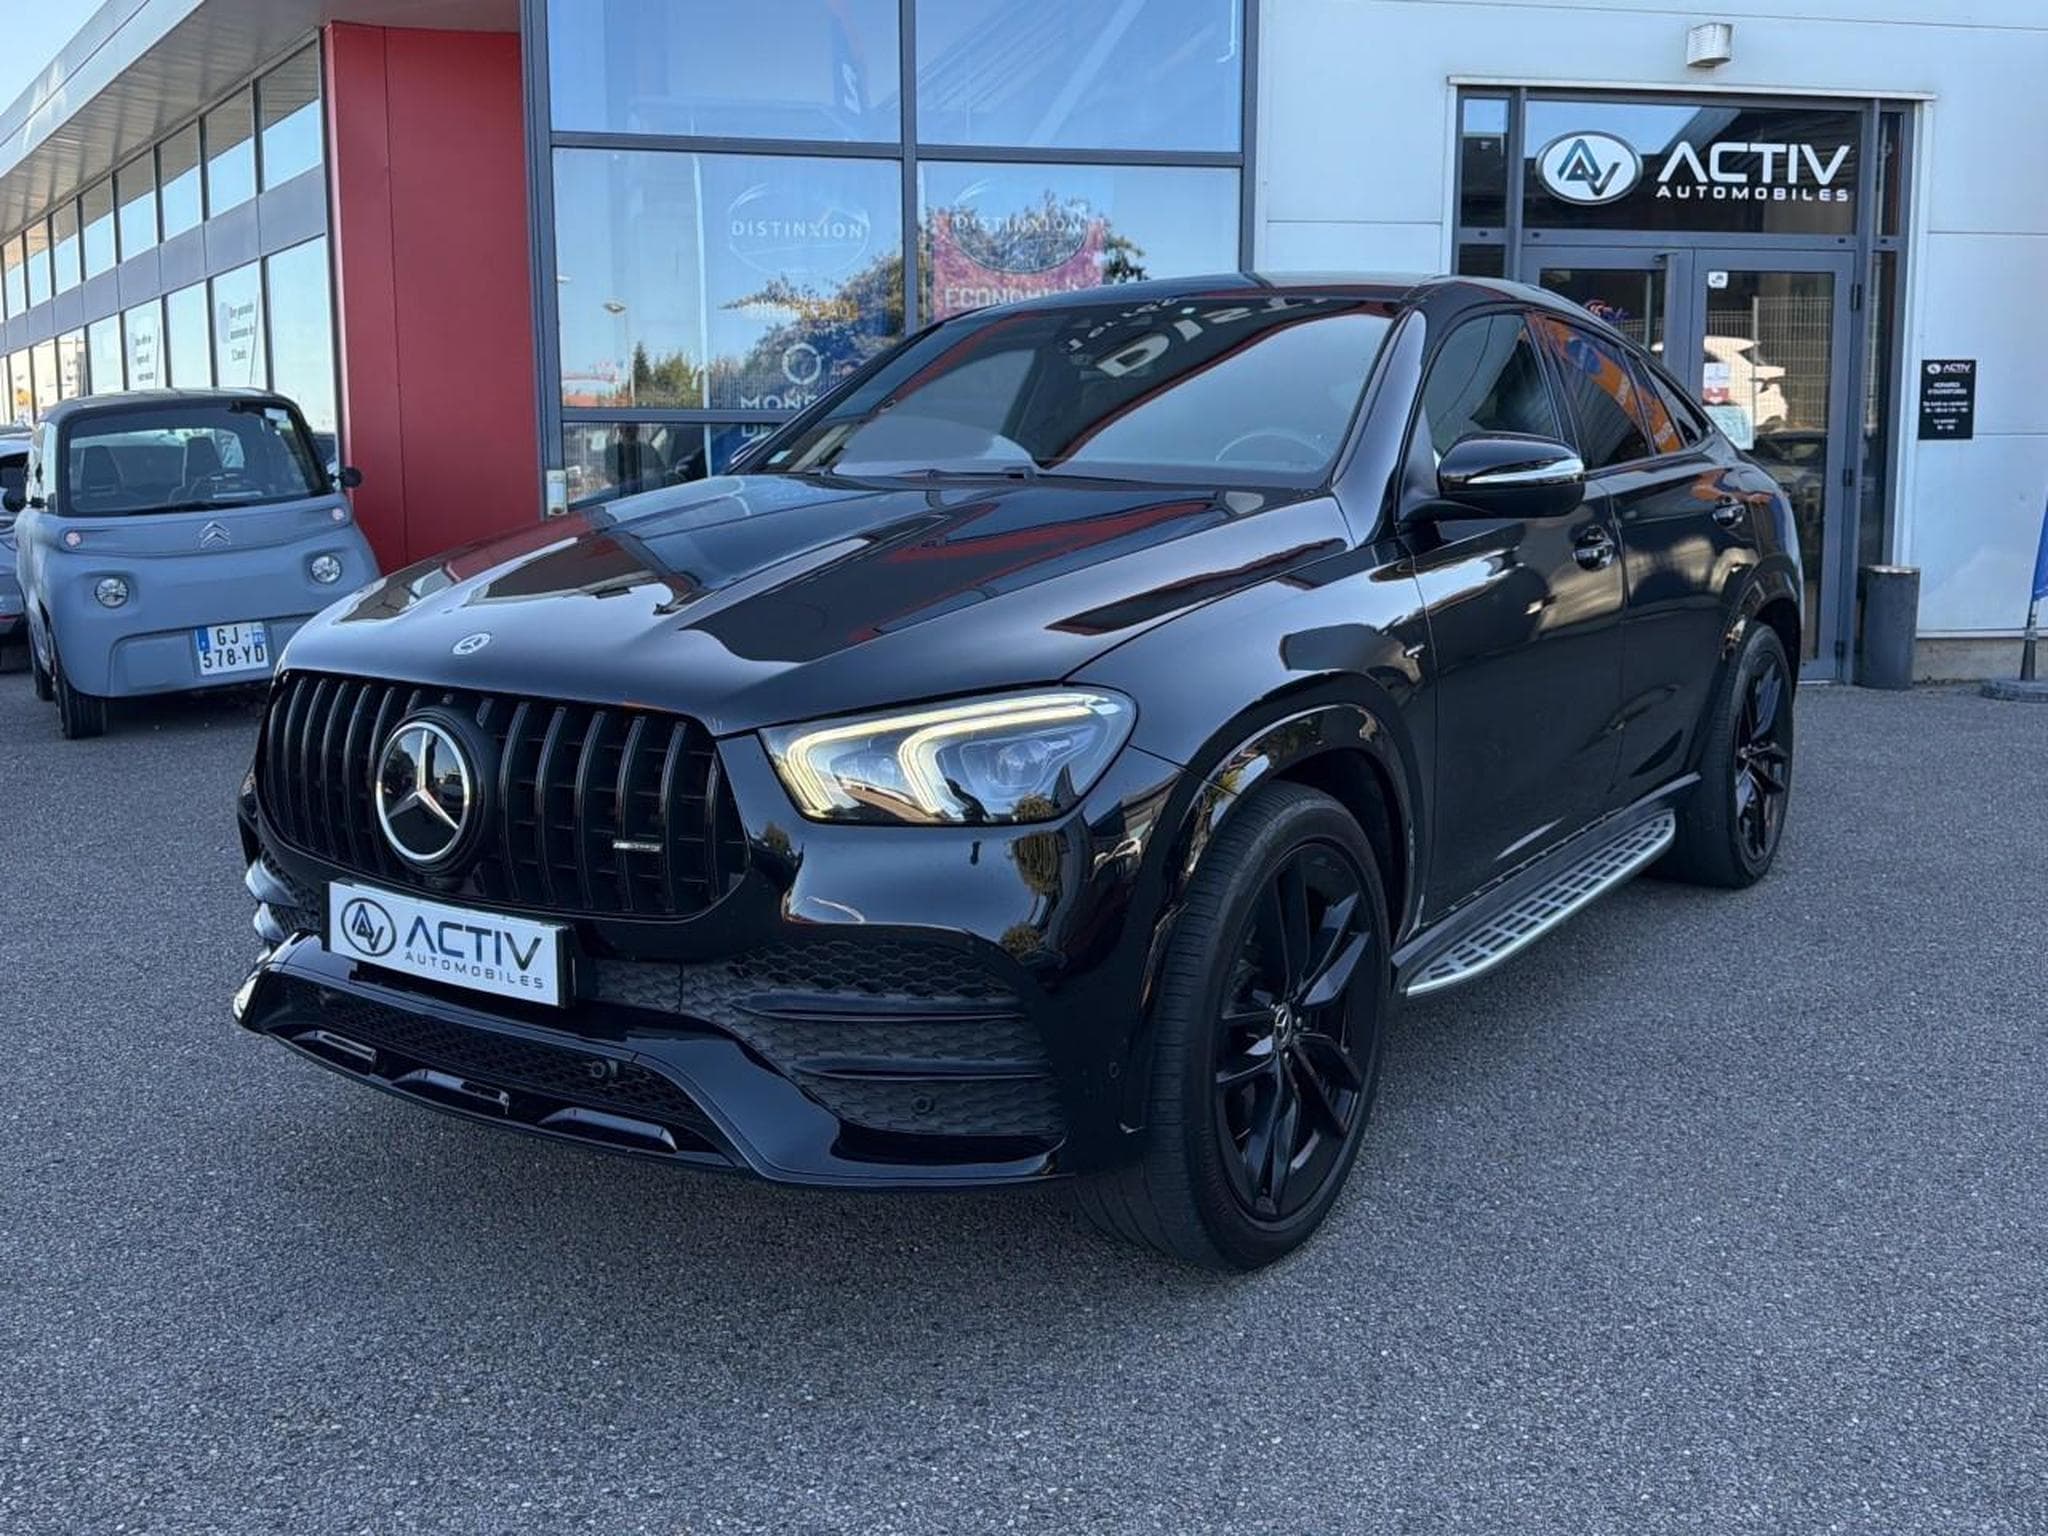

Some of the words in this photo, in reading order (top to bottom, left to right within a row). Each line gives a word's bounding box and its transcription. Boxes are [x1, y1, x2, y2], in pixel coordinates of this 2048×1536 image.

[1656, 140, 1852, 186] ACTIV
[1655, 184, 1849, 203] AUTOMOBILES
[731, 219, 863, 240] DISTINXION
[202, 645, 265, 669] 578-YD
[405, 915, 542, 972] ACTIV
[404, 951, 544, 989] AUTOMOBILES
